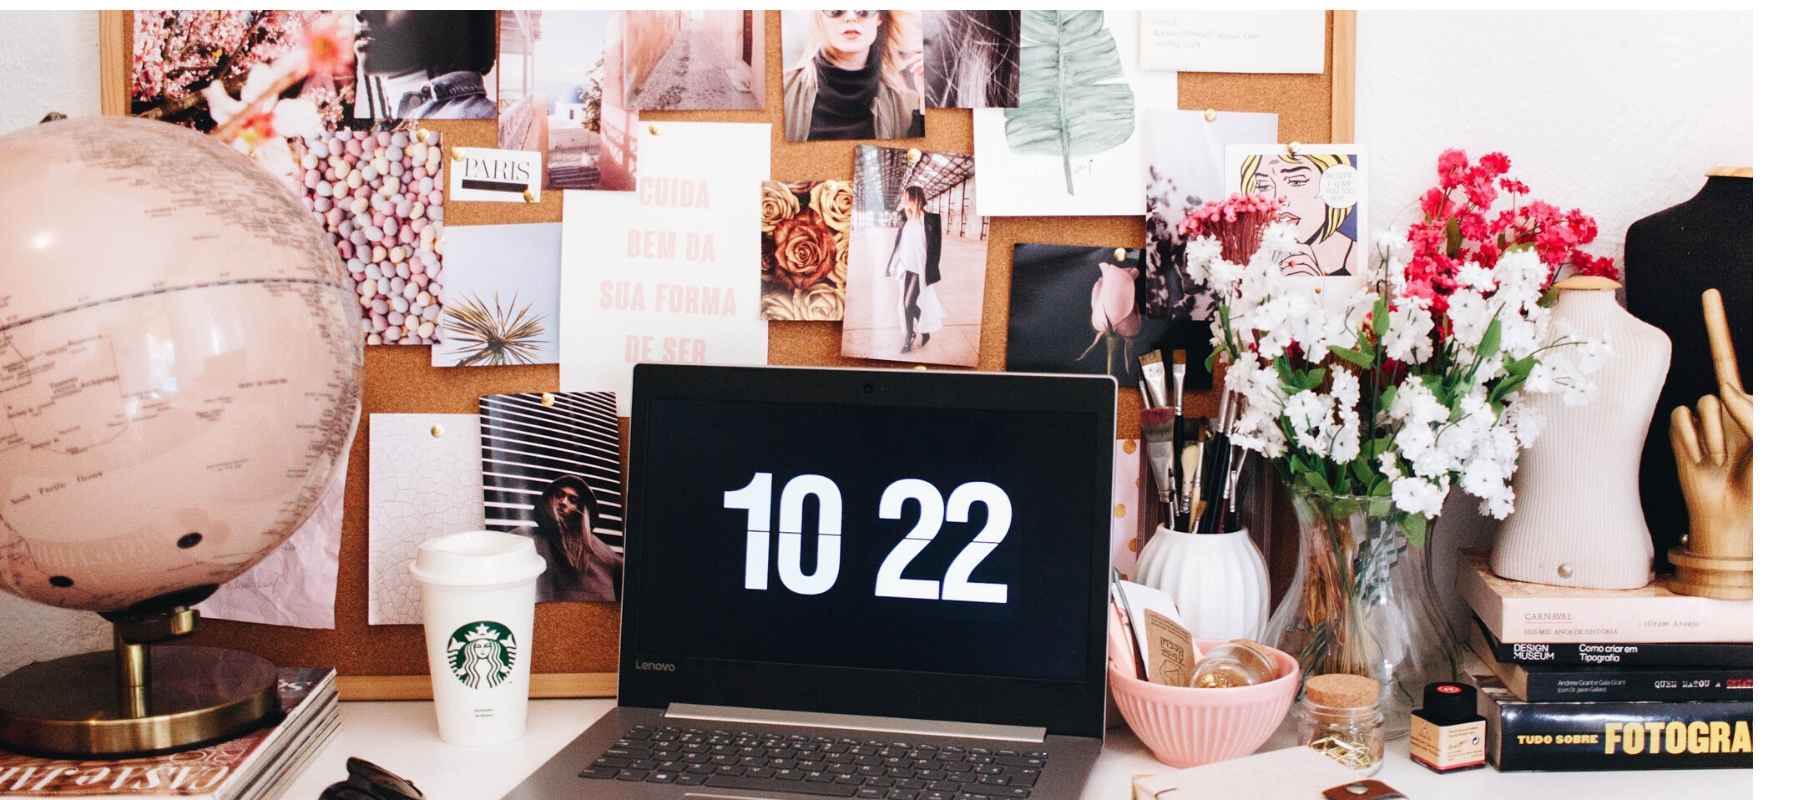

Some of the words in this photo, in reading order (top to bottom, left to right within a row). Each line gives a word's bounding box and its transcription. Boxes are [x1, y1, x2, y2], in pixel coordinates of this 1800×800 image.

[465, 157, 530, 181] PARIS
[639, 176, 710, 208] CUIDA
[626, 228, 677, 260] BEM
[685, 231, 716, 263] DA
[599, 280, 647, 312] SUA
[655, 282, 737, 317] FORMA
[624, 335, 654, 363] DE
[662, 336, 706, 364] SER
[723, 472, 842, 595] 10
[874, 478, 1013, 604] 22
[1524, 612, 1572, 621] CARNAVAL
[1513, 643, 1550, 652] DESIGN
[1513, 651, 1555, 660] MUSEUM
[1579, 644, 1603, 653] Como
[1605, 645, 1624, 653] criar
[635, 659, 676, 672] Lenovo
[1579, 653, 1620, 663] Tipografia
[1654, 680, 1677, 689] QUEM
[1682, 680, 1710, 688] MATOU
[1517, 735, 1553, 745] TUDO
[1555, 734, 1599, 745] SOBRE
[1604, 721, 1753, 755] FOTOGRA
